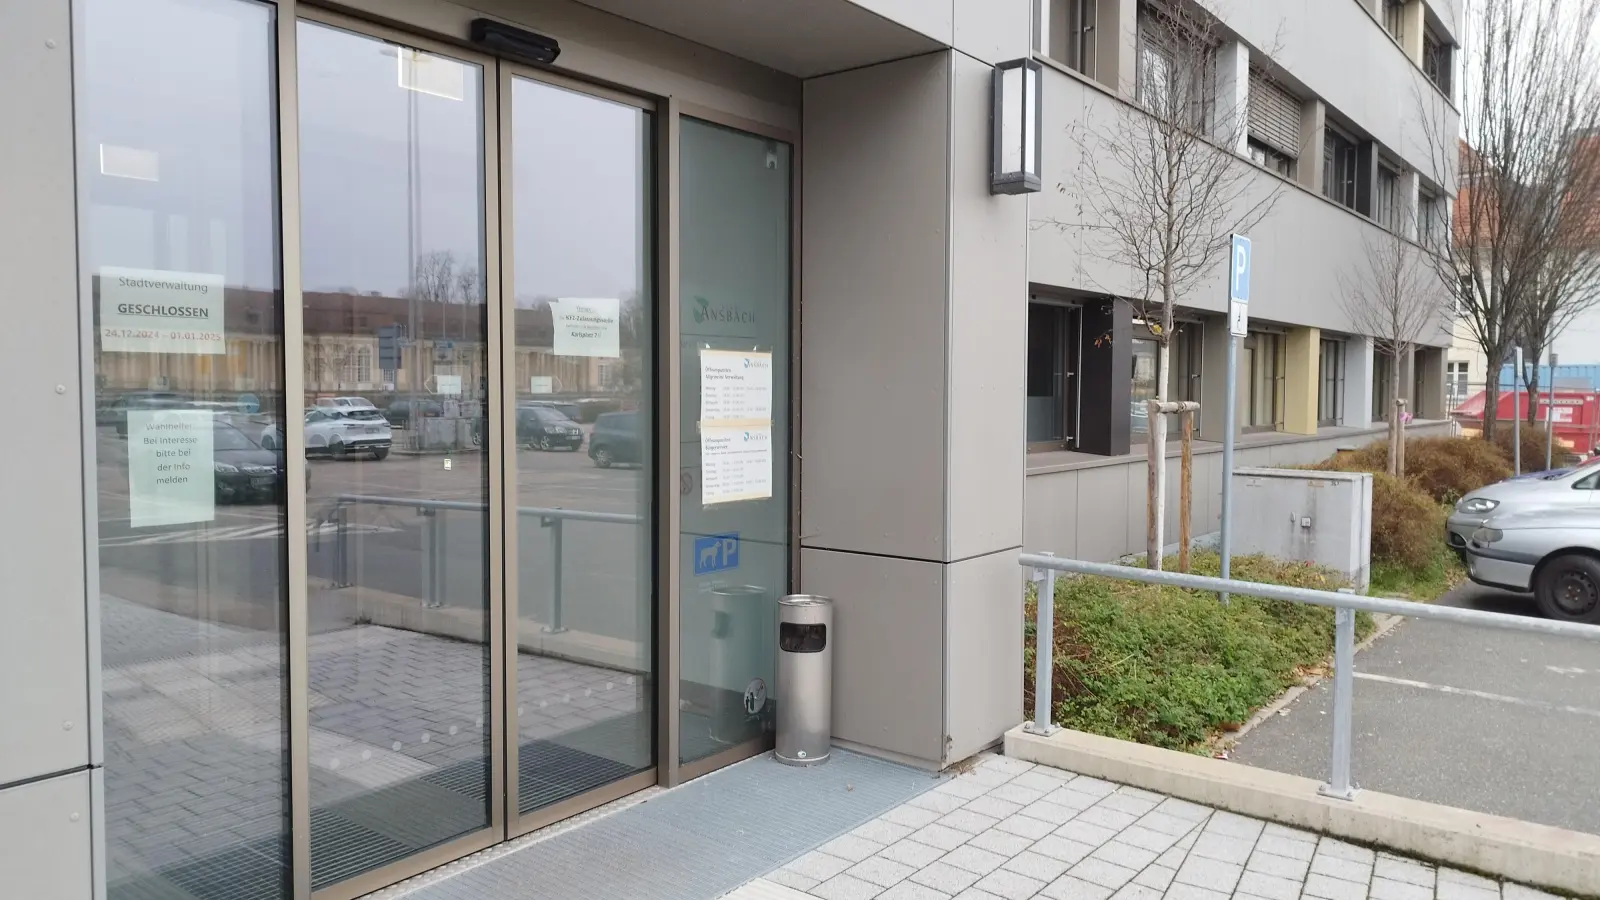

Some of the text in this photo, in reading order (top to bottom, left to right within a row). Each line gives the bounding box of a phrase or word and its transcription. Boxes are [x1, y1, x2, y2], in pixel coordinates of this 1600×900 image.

[1236, 244, 1246, 291] P
[119, 276, 208, 295] Stadtverwaltung
[118, 303, 209, 318] GESCHLOSSEN
[701, 305, 755, 324] ANSBACH
[105, 328, 159, 339] 24.12.2024
[170, 331, 222, 341] 01.01.2025
[143, 436, 198, 445] Bei Interesse
[156, 448, 191, 458] bitte bei
[157, 461, 191, 472] der Info
[156, 475, 188, 485] melden
[722, 538, 737, 567] P
